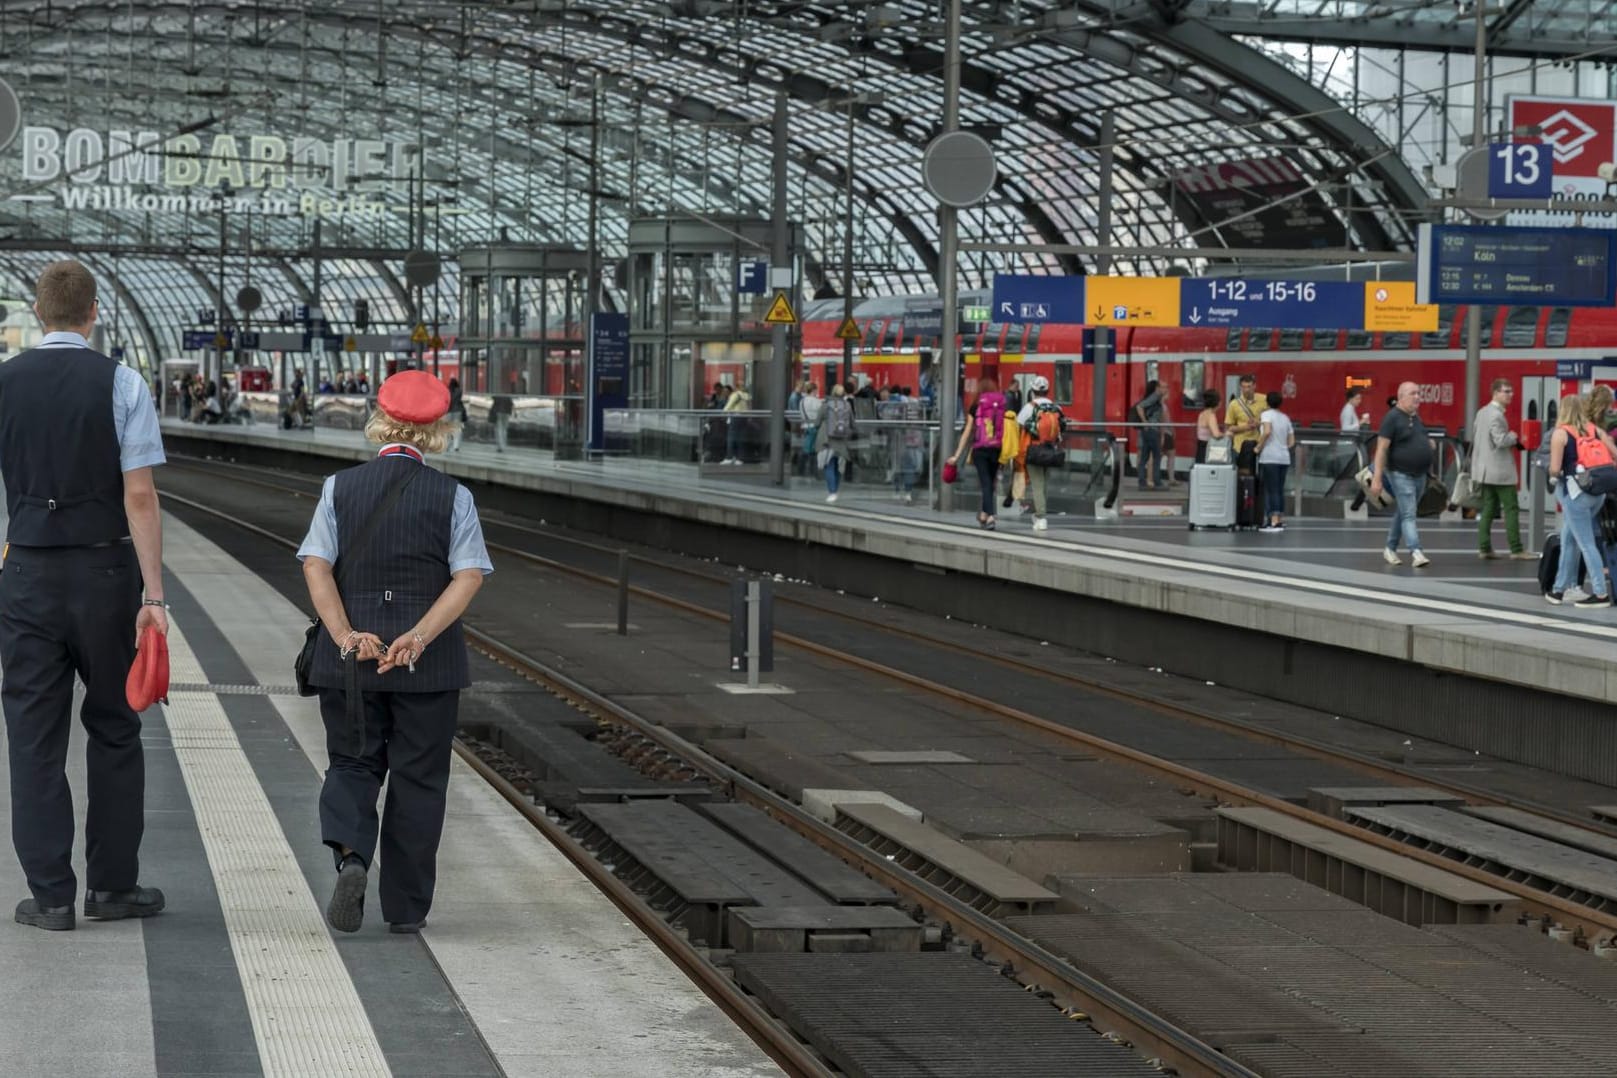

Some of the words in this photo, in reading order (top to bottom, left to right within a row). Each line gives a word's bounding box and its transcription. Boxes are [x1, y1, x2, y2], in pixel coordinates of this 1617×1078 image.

[22, 125, 427, 192] BOMBARDIER
[1497, 144, 1540, 185] 13
[62, 186, 249, 213] Willkommen
[256, 191, 290, 214] in
[299, 194, 386, 216] Berlin
[740, 262, 756, 288] F
[1208, 280, 1247, 300] 1-12
[1266, 281, 1316, 302] 15-16
[295, 306, 304, 319] E
[1207, 306, 1239, 317] Ausgang
